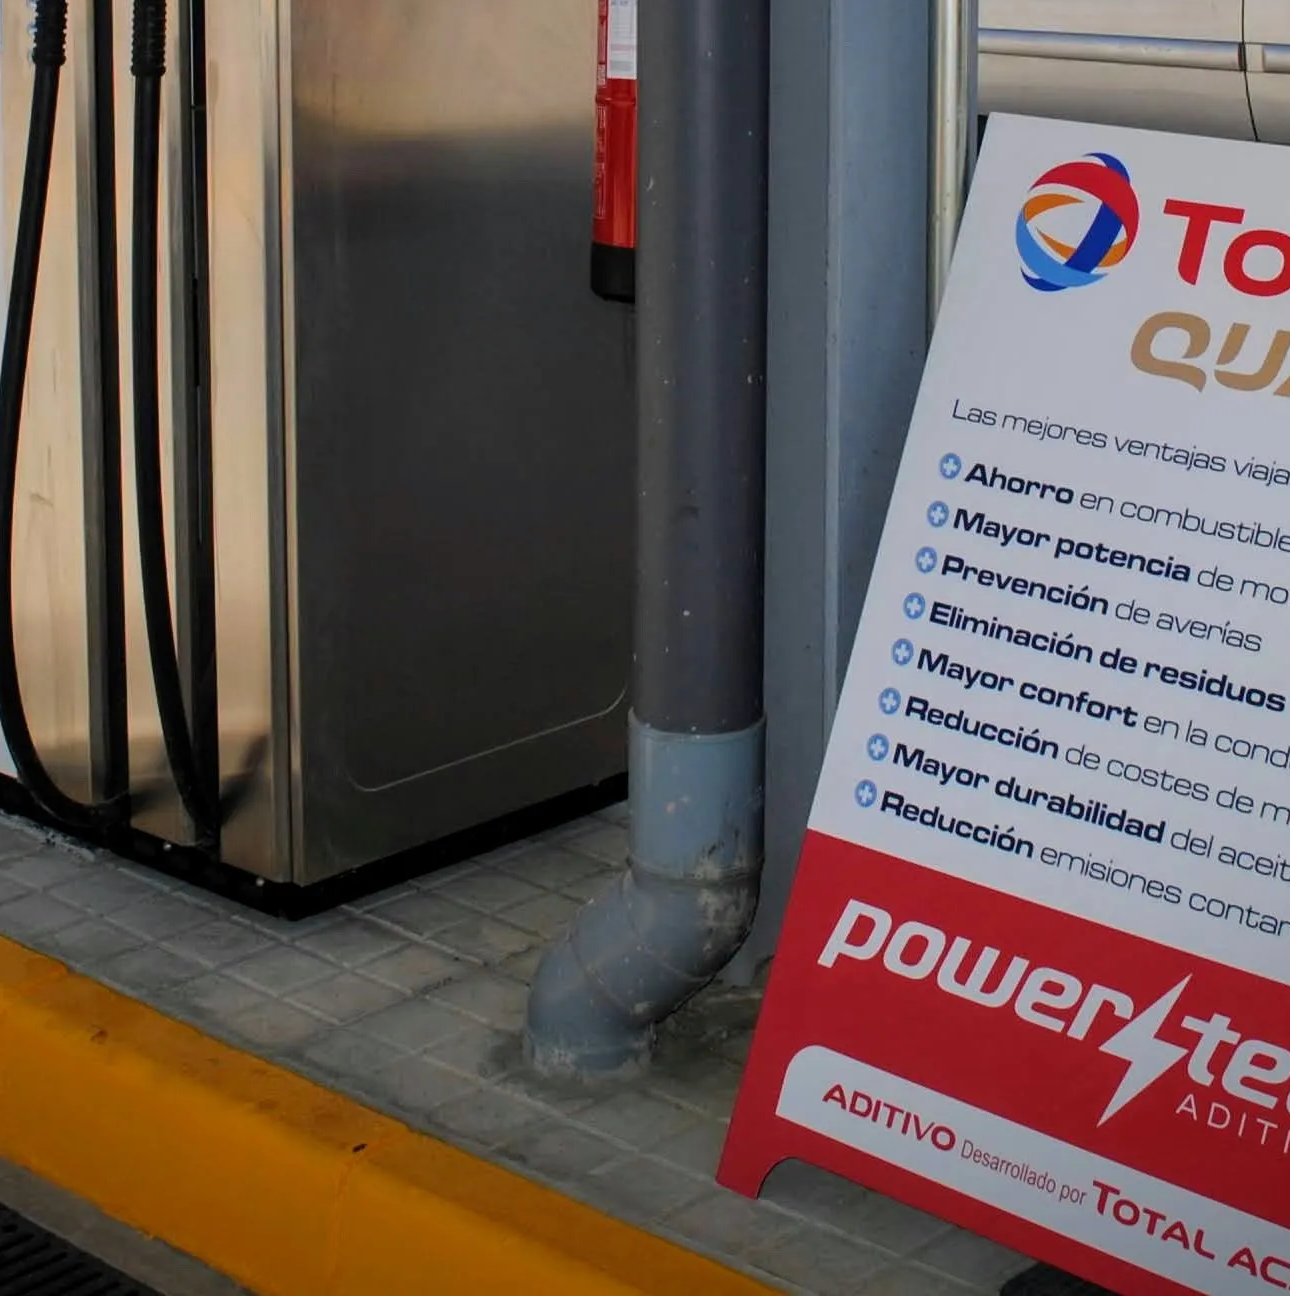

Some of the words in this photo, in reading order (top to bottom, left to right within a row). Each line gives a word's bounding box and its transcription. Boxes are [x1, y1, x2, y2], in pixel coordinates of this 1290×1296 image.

[951, 398, 997, 426] Las
[1001, 413, 1109, 449] mejores
[1114, 435, 1227, 474] ventajas
[964, 462, 1075, 505] Ahorro
[1079, 491, 1115, 514] en
[941, 554, 1109, 616] Prevención
[1114, 600, 1151, 625] de
[1155, 612, 1263, 652] averías
[952, 508, 1051, 547] Mayor
[1053, 536, 1191, 583] potencia
[1196, 566, 1235, 592] de
[916, 648, 1014, 690] Mayor
[1019, 680, 1139, 728] confort
[1143, 715, 1180, 740] en
[1185, 719, 1209, 747] la
[928, 601, 1093, 664] Eliminación
[1099, 647, 1139, 674] de
[1143, 661, 1287, 712] residuos
[892, 742, 990, 787] Mayor
[994, 776, 1167, 844] durabilidad
[1170, 828, 1215, 859] del
[904, 695, 1060, 760] Reducción
[1064, 744, 1101, 771] de
[1106, 759, 1209, 803] costes
[1215, 786, 1255, 814] de
[879, 789, 1035, 859] Reducción
[1040, 846, 1182, 906] emisiones
[816, 898, 1135, 1041] power
[822, 1083, 957, 1153] ADITIVO
[959, 1137, 1058, 1195] Desarrollado
[1057, 1180, 1088, 1208] por
[1092, 1178, 1216, 1261] TOTAL
